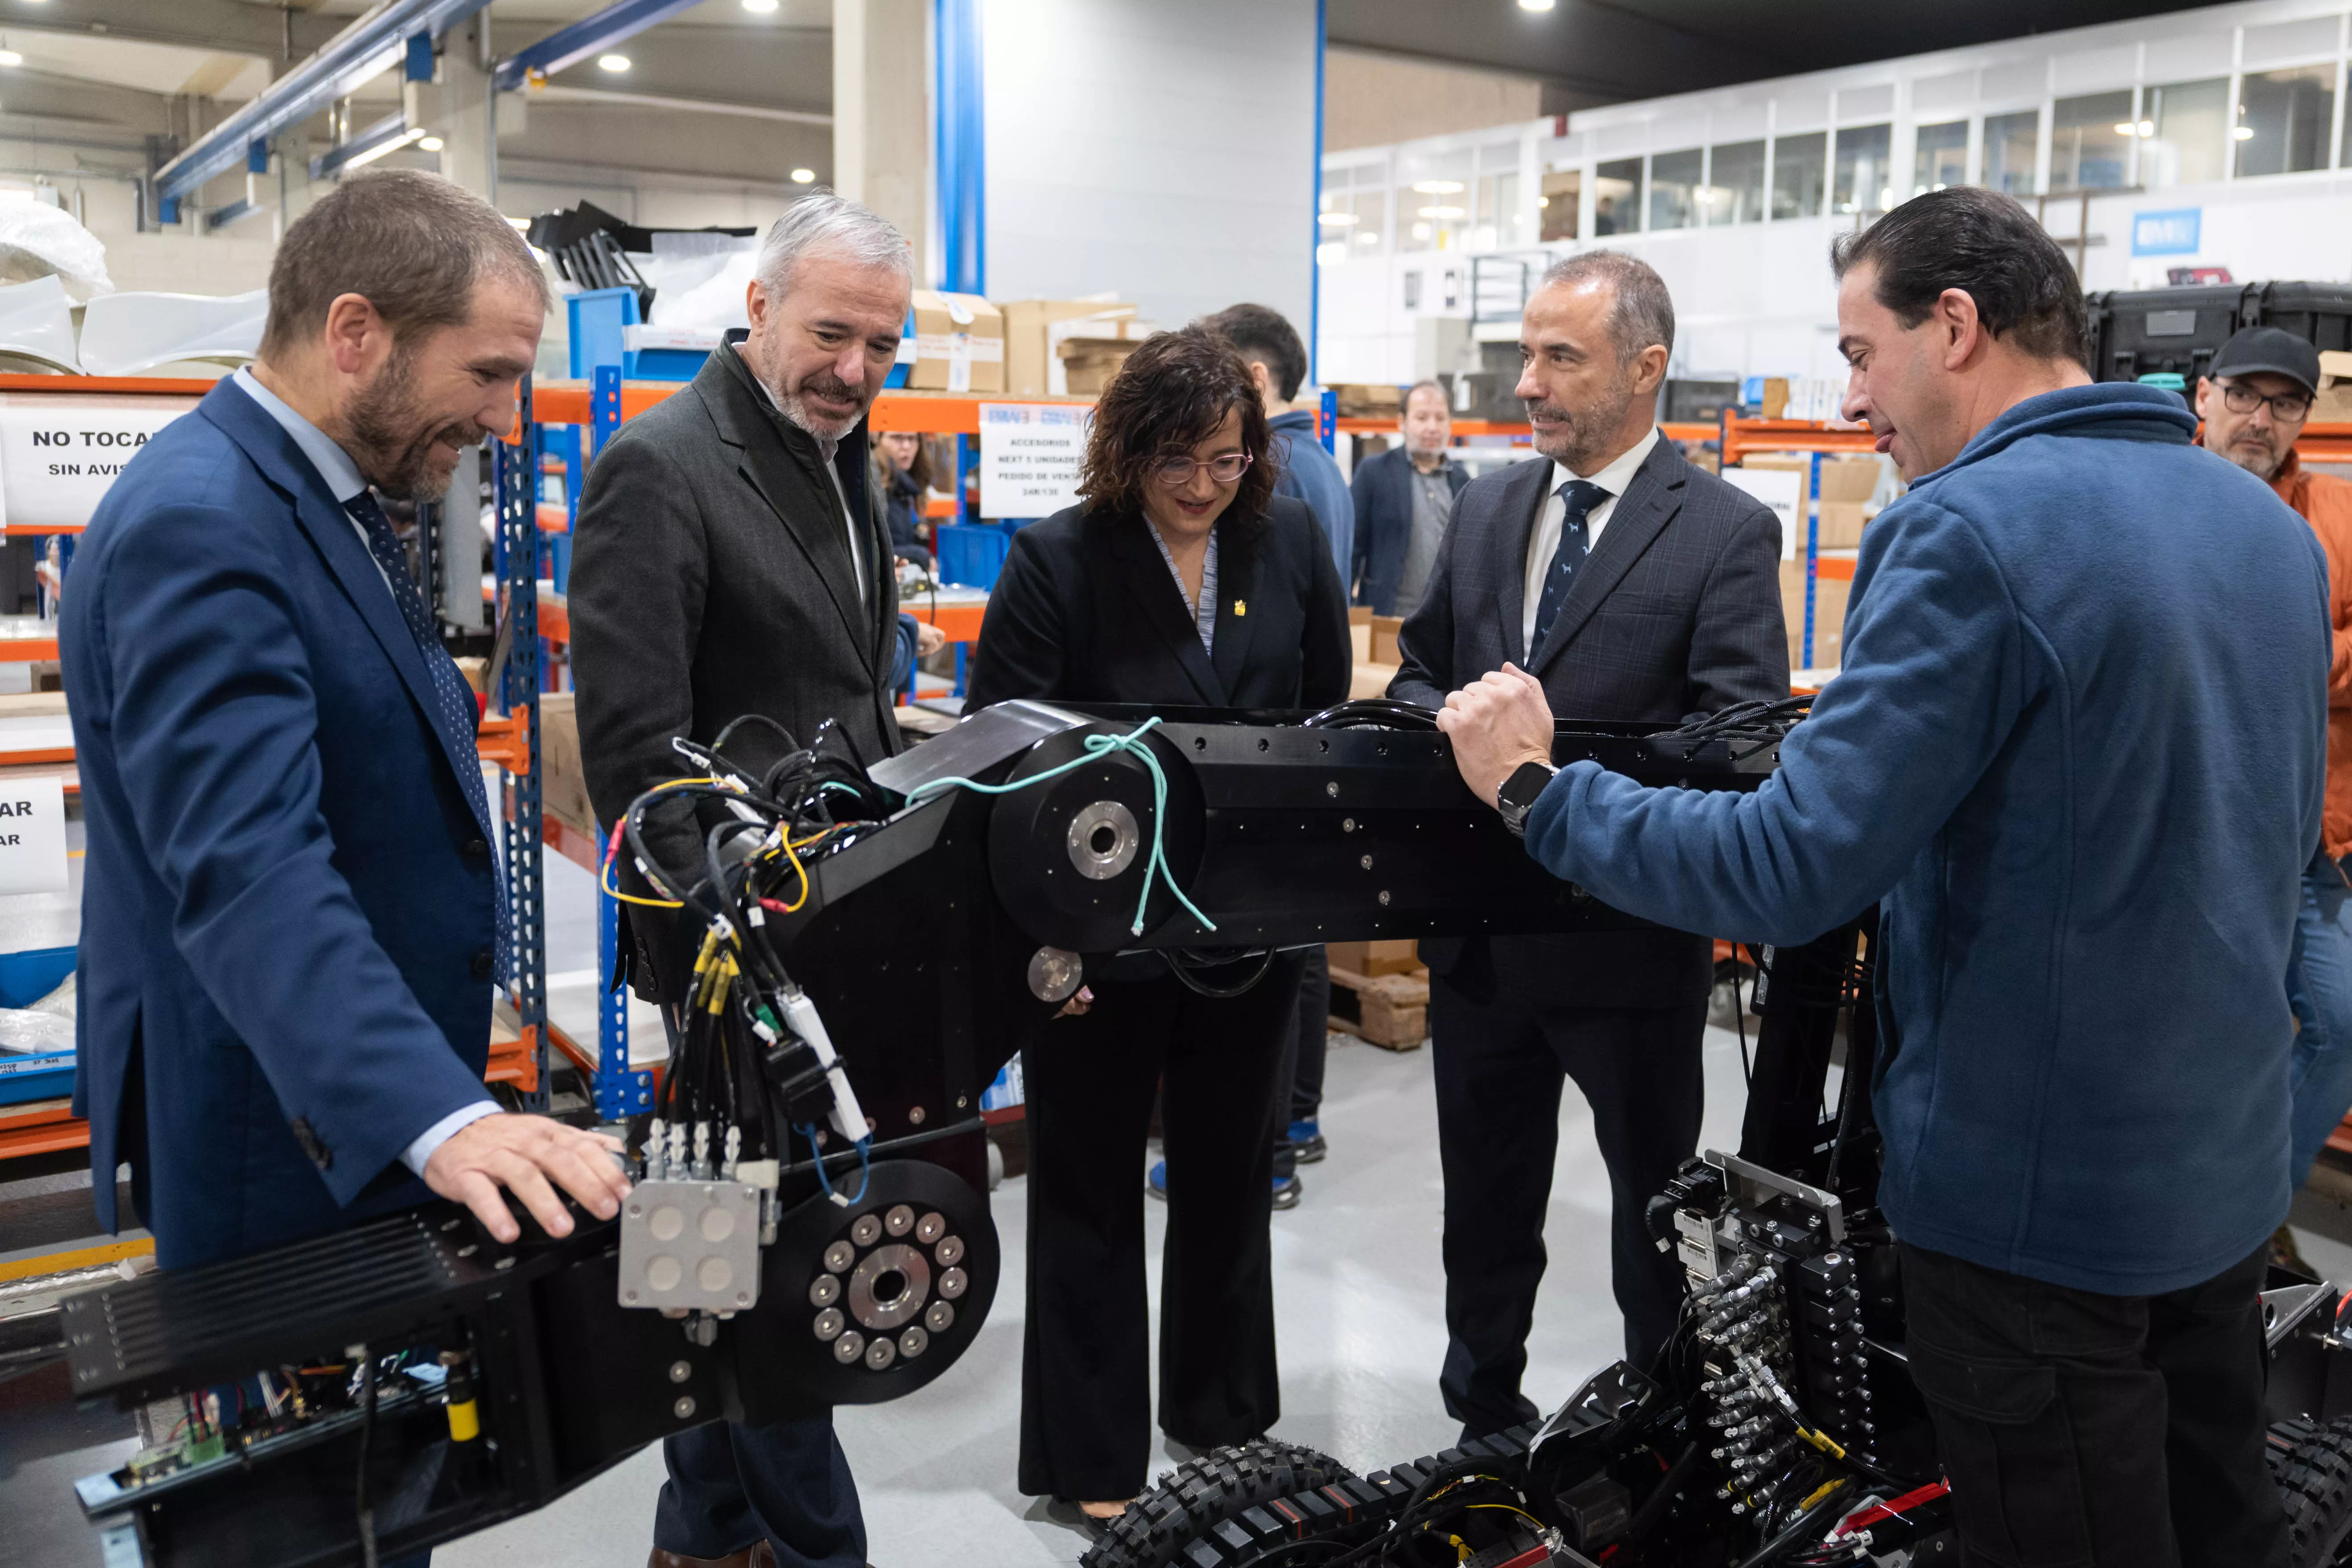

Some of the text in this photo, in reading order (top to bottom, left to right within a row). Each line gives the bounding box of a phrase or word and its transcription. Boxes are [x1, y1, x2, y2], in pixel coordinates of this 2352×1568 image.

[33, 432, 155, 446] NO TOCA
[49, 464, 80, 475] SIN
